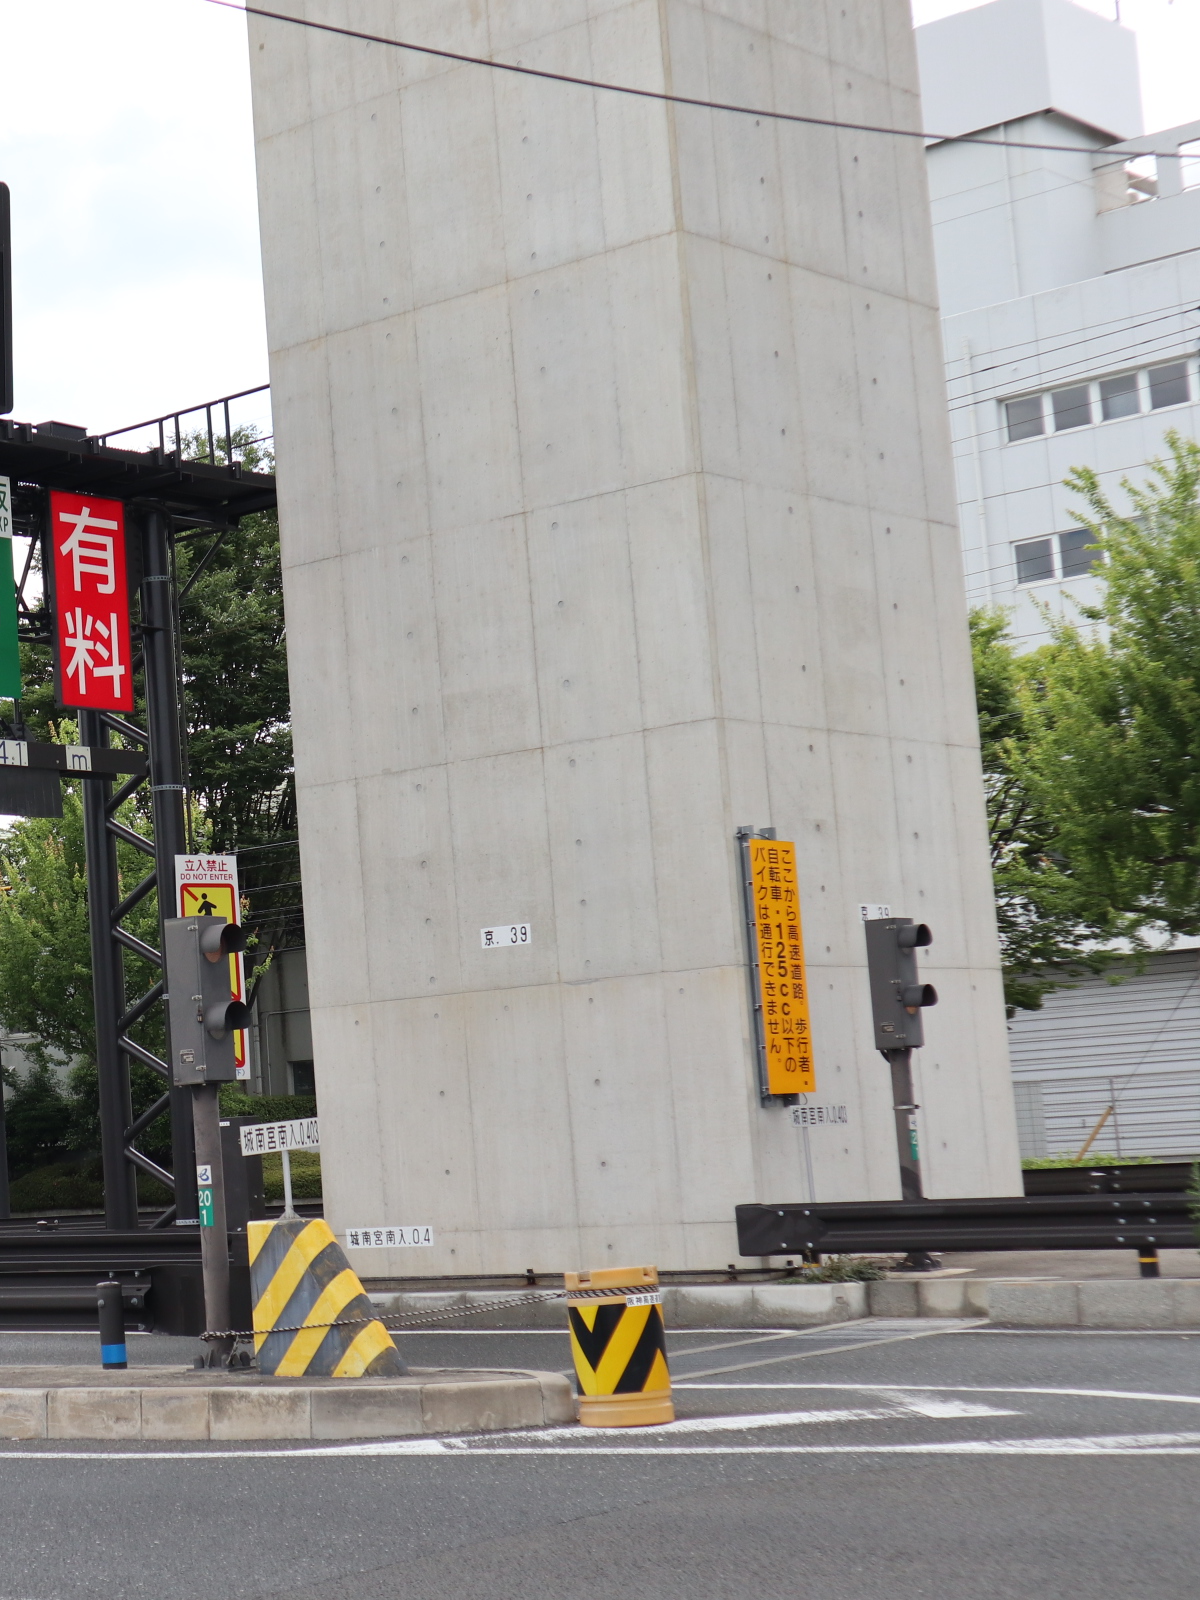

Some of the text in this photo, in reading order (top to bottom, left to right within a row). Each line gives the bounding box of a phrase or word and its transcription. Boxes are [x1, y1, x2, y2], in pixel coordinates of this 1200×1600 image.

[58, 506, 126, 698] 有料
[184, 859, 229, 872] 立入禁止
[180, 873, 234, 881] DO NOT ENTER
[510, 926, 528, 944] 39
[198, 1190, 211, 1207] 20
[201, 1209, 208, 1226] 1
